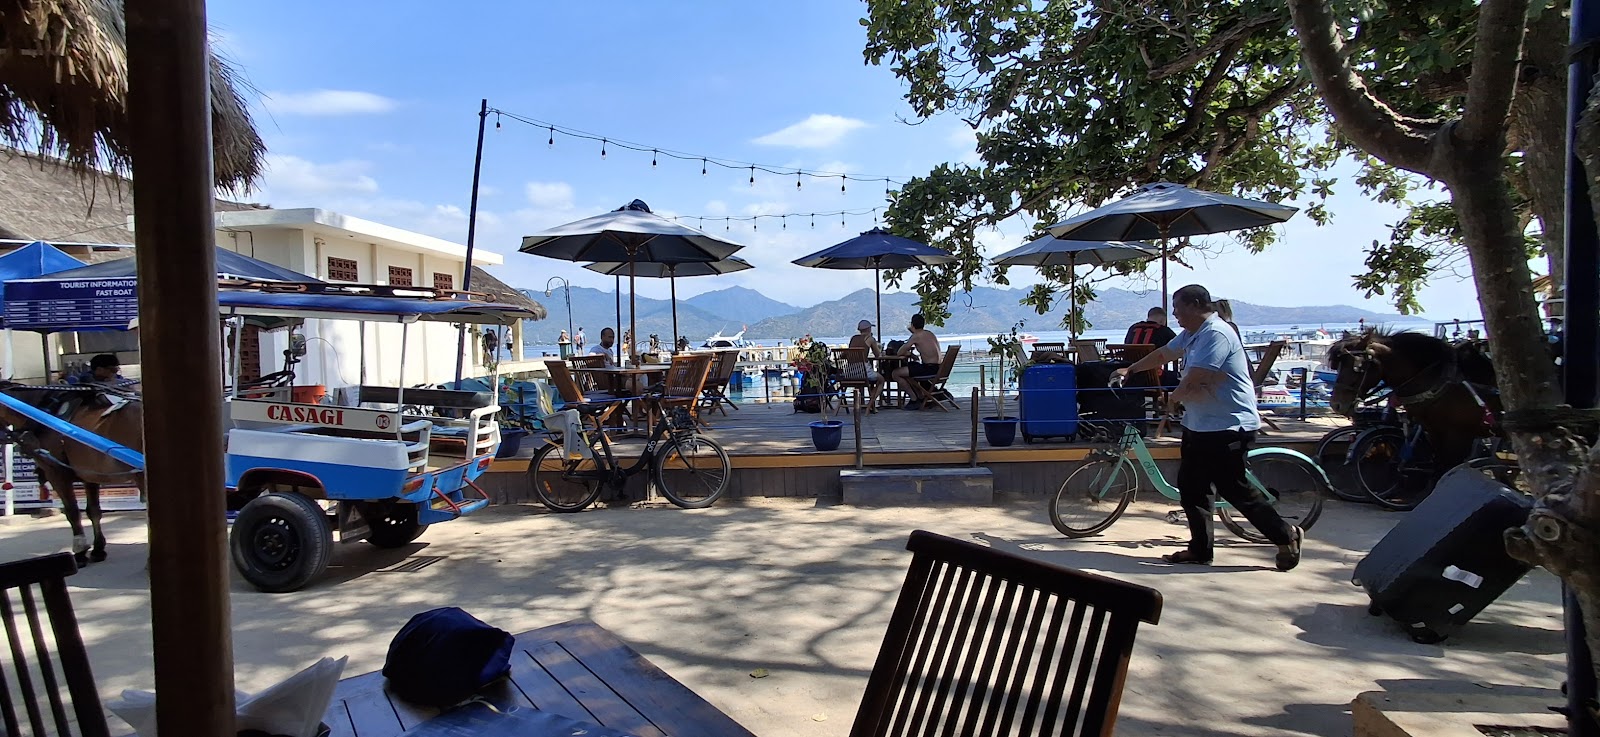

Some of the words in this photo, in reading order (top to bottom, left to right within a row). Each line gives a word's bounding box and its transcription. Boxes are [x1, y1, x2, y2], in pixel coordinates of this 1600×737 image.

[1132, 327, 1154, 345] 11
[267, 405, 344, 426] CASAGI
[376, 417, 390, 428] 03
